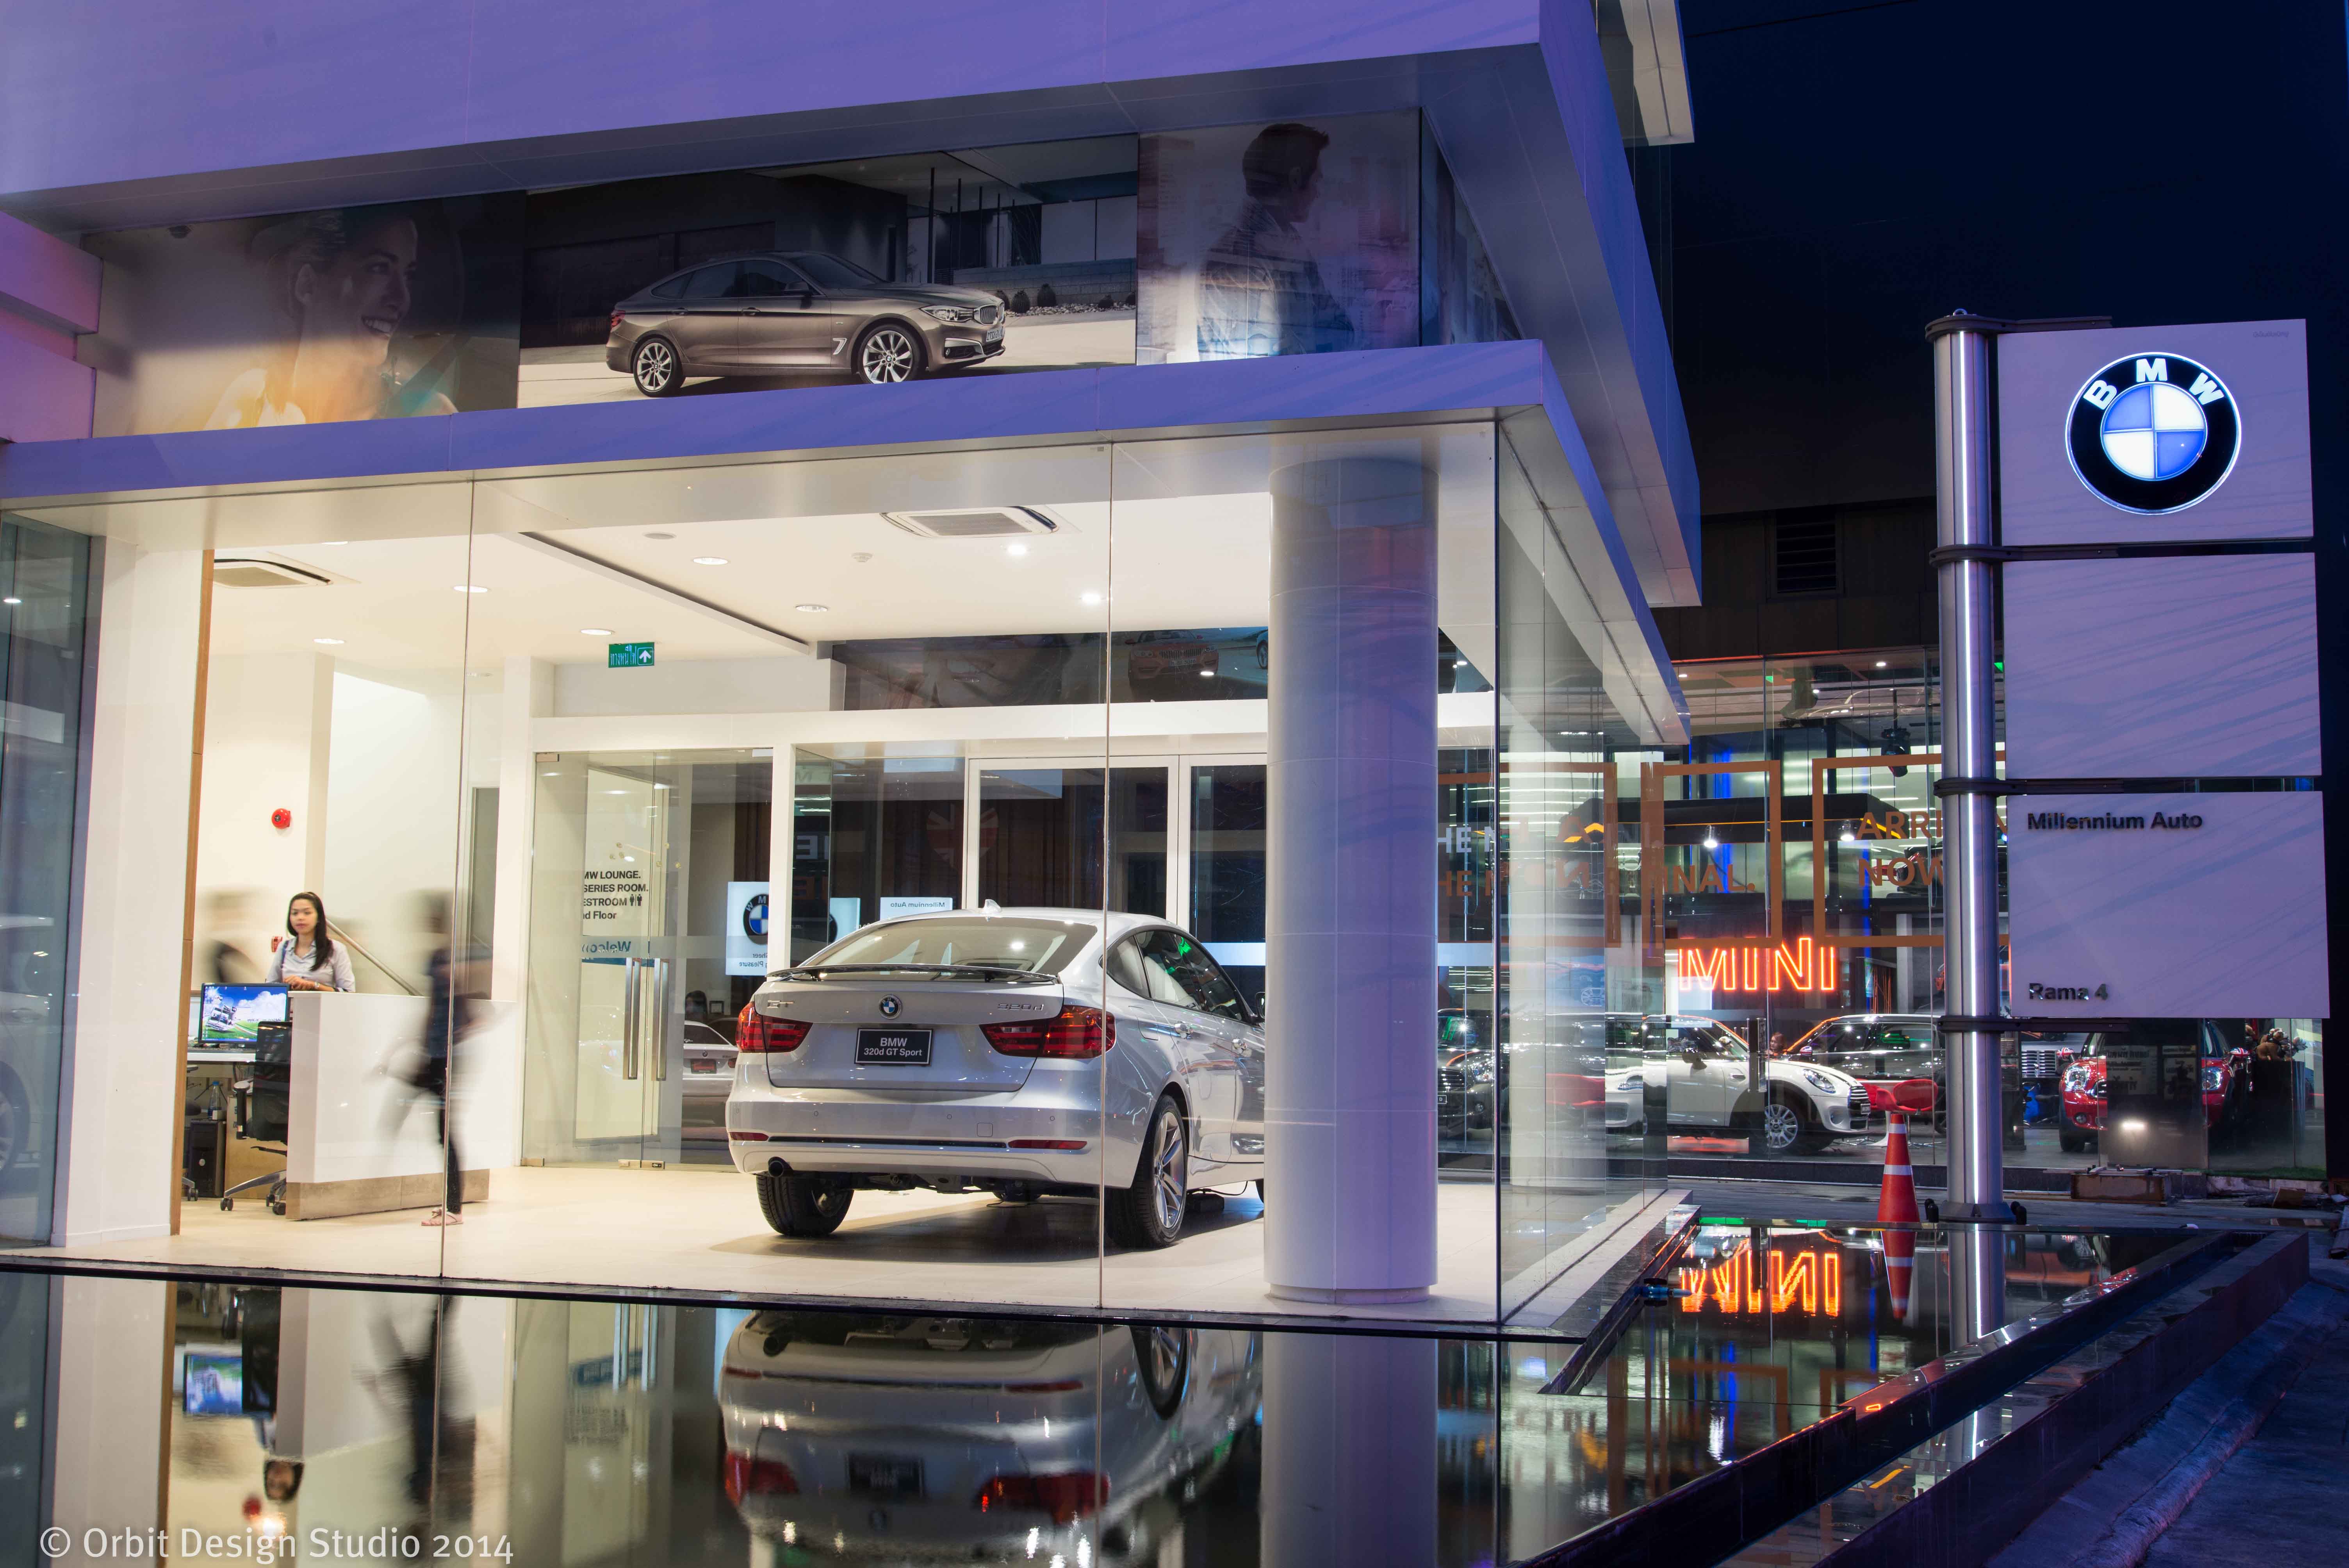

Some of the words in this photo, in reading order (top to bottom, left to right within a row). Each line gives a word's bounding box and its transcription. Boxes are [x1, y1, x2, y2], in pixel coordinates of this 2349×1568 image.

[2083, 358, 2224, 410] BMW
[611, 645, 636, 665] ทางหนีไฟ
[1855, 811, 1942, 839] ARRI
[2028, 812, 2144, 829] Millennium
[2151, 812, 2202, 829] Auto
[600, 871, 641, 879] LOUNGE.
[1663, 864, 1756, 893] INAL.
[617, 884, 649, 892] ROOM.
[593, 911, 617, 919] Floor
[1679, 937, 1835, 991] MINI
[2029, 983, 2089, 1000] Rama
[2094, 984, 2108, 1000] 4
[880, 1037, 907, 1047] BMW
[899, 1049, 922, 1057] Sport
